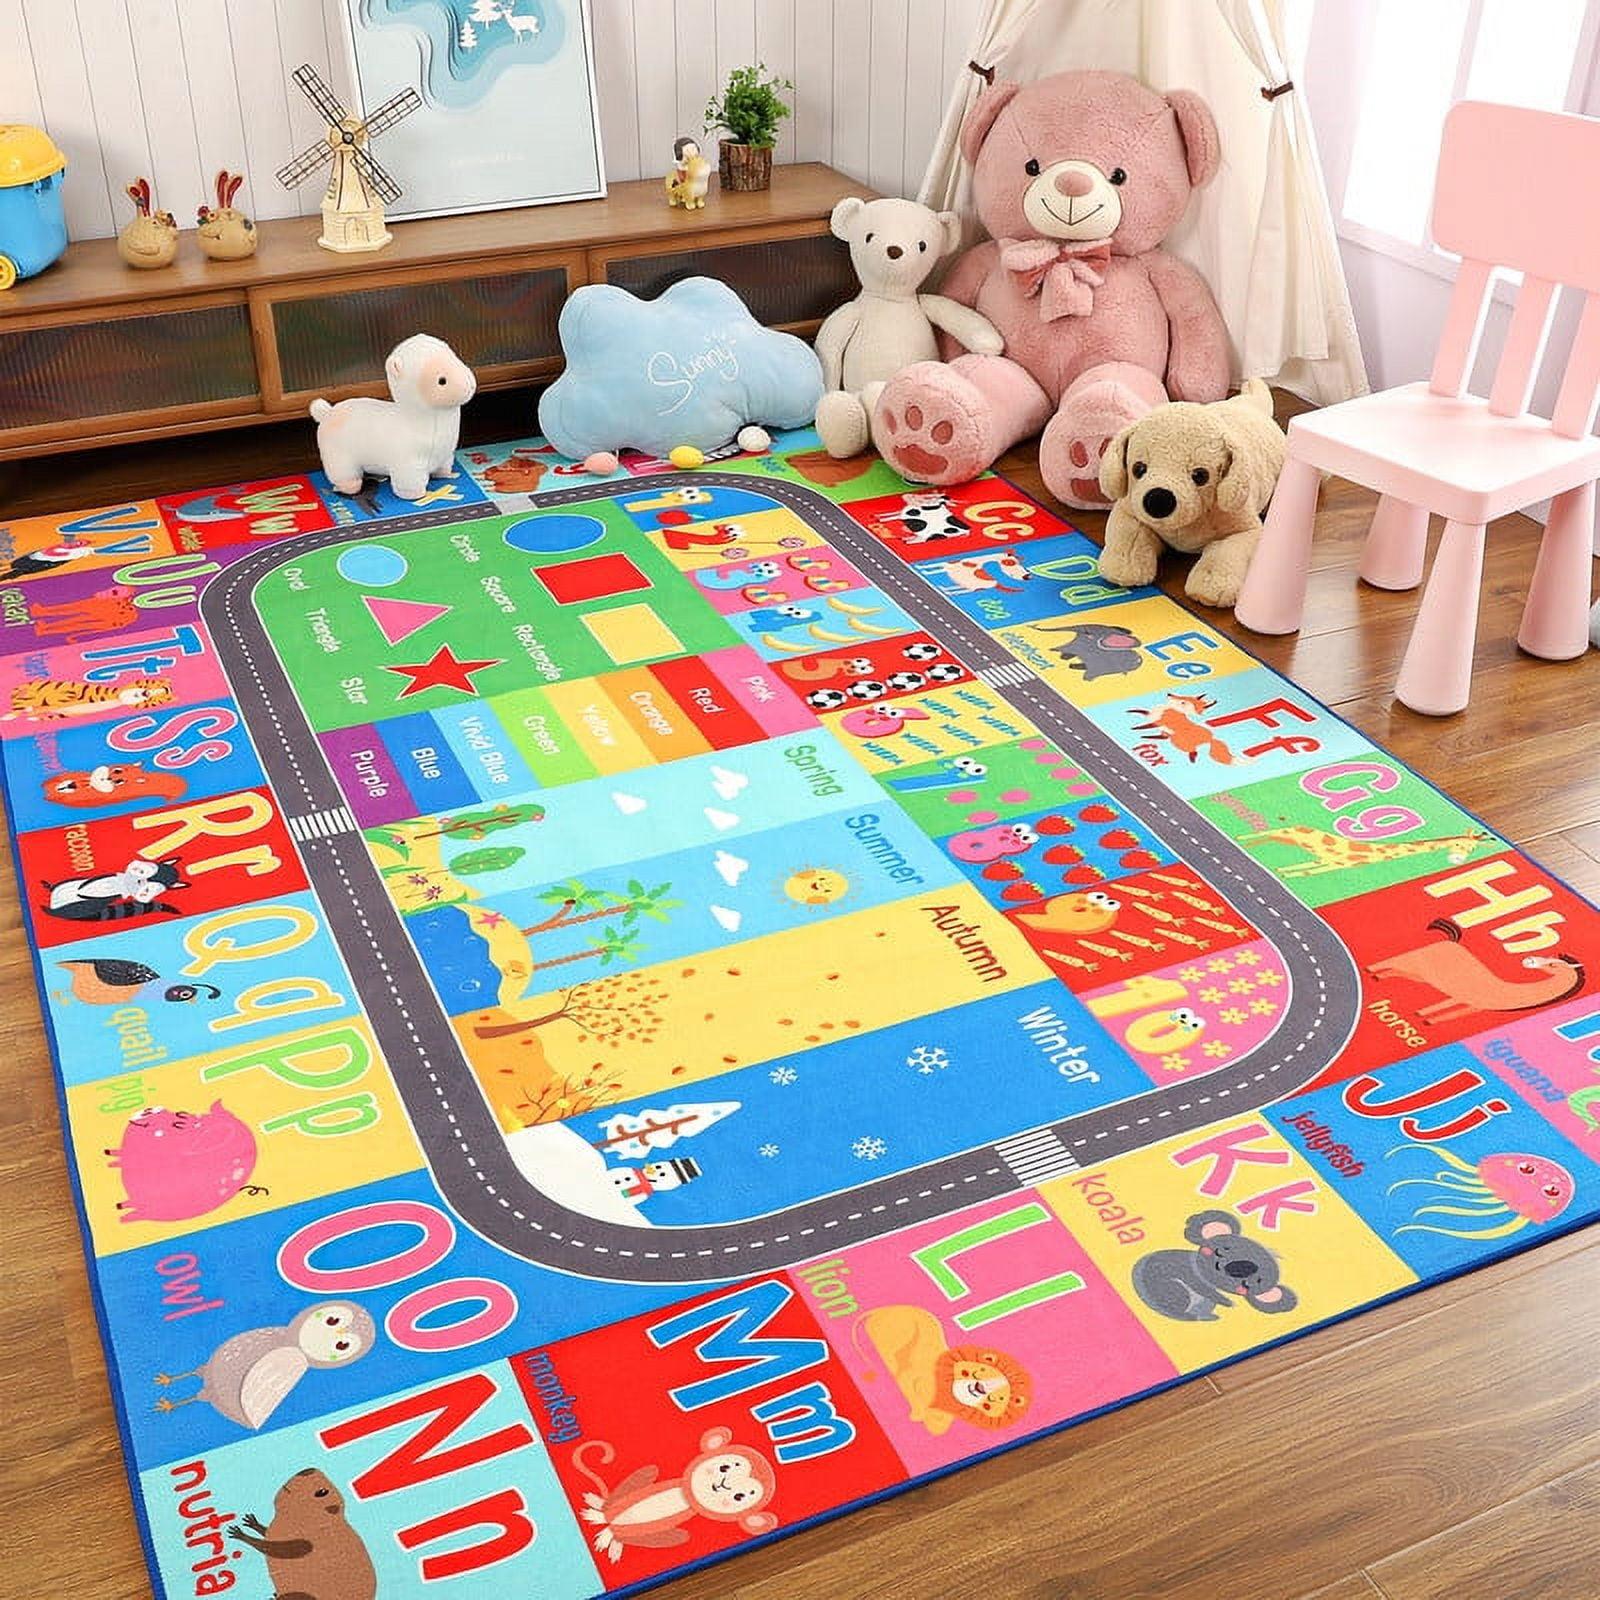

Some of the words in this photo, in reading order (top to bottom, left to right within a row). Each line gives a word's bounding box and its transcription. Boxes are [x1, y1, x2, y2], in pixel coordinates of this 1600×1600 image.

[56, 506, 159, 555] Vv
[235, 483, 318, 535] Ww
[661, 522, 745, 551] 2
[963, 501, 1037, 541] Cc
[112, 552, 222, 609] Uu
[695, 560, 783, 591] 3
[1029, 553, 1133, 606] Dd
[81, 623, 205, 684] Tt
[305, 607, 344, 654] Triangle
[1143, 630, 1219, 679] Ee
[741, 674, 777, 705] Pink
[781, 655, 876, 682] 5
[580, 703, 618, 746] Yellow
[628, 690, 675, 737] Orange
[688, 686, 726, 715] Red
[839, 700, 931, 738] 6
[1205, 696, 1321, 759] Ff
[105, 705, 240, 770] Ss
[411, 746, 441, 781] Blue
[523, 714, 561, 756] Green
[1132, 743, 1169, 767] fox
[350, 748, 388, 800] Purple
[480, 750, 510, 786] Blue
[783, 744, 845, 799] Spring
[1299, 760, 1426, 841] Gg
[132, 790, 283, 877] Rr
[844, 812, 925, 889] Summer
[947, 822, 1040, 864] 8
[1422, 859, 1567, 954] Hh
[179, 902, 347, 1033] Qq
[920, 904, 1008, 984] Autumn
[104, 1006, 169, 1068] quail
[1084, 972, 1207, 1055] 10
[1367, 998, 1428, 1049] horse
[1015, 1005, 1101, 1089] Winter
[96, 1073, 157, 1116] pig
[200, 1025, 382, 1139] Pp
[1342, 1069, 1511, 1143] Jj
[1282, 1110, 1365, 1179] jellyfish
[1170, 1120, 1317, 1233] Kk
[1070, 1172, 1146, 1247] koala
[155, 1251, 226, 1323] owl
[276, 1199, 520, 1353] Oo
[796, 1256, 860, 1321] lion
[909, 1201, 1088, 1332] Ll
[525, 1351, 584, 1446] monkey
[645, 1278, 858, 1465] Mm
[315, 1370, 540, 1585] Nn
[169, 1459, 243, 1597] nutria
